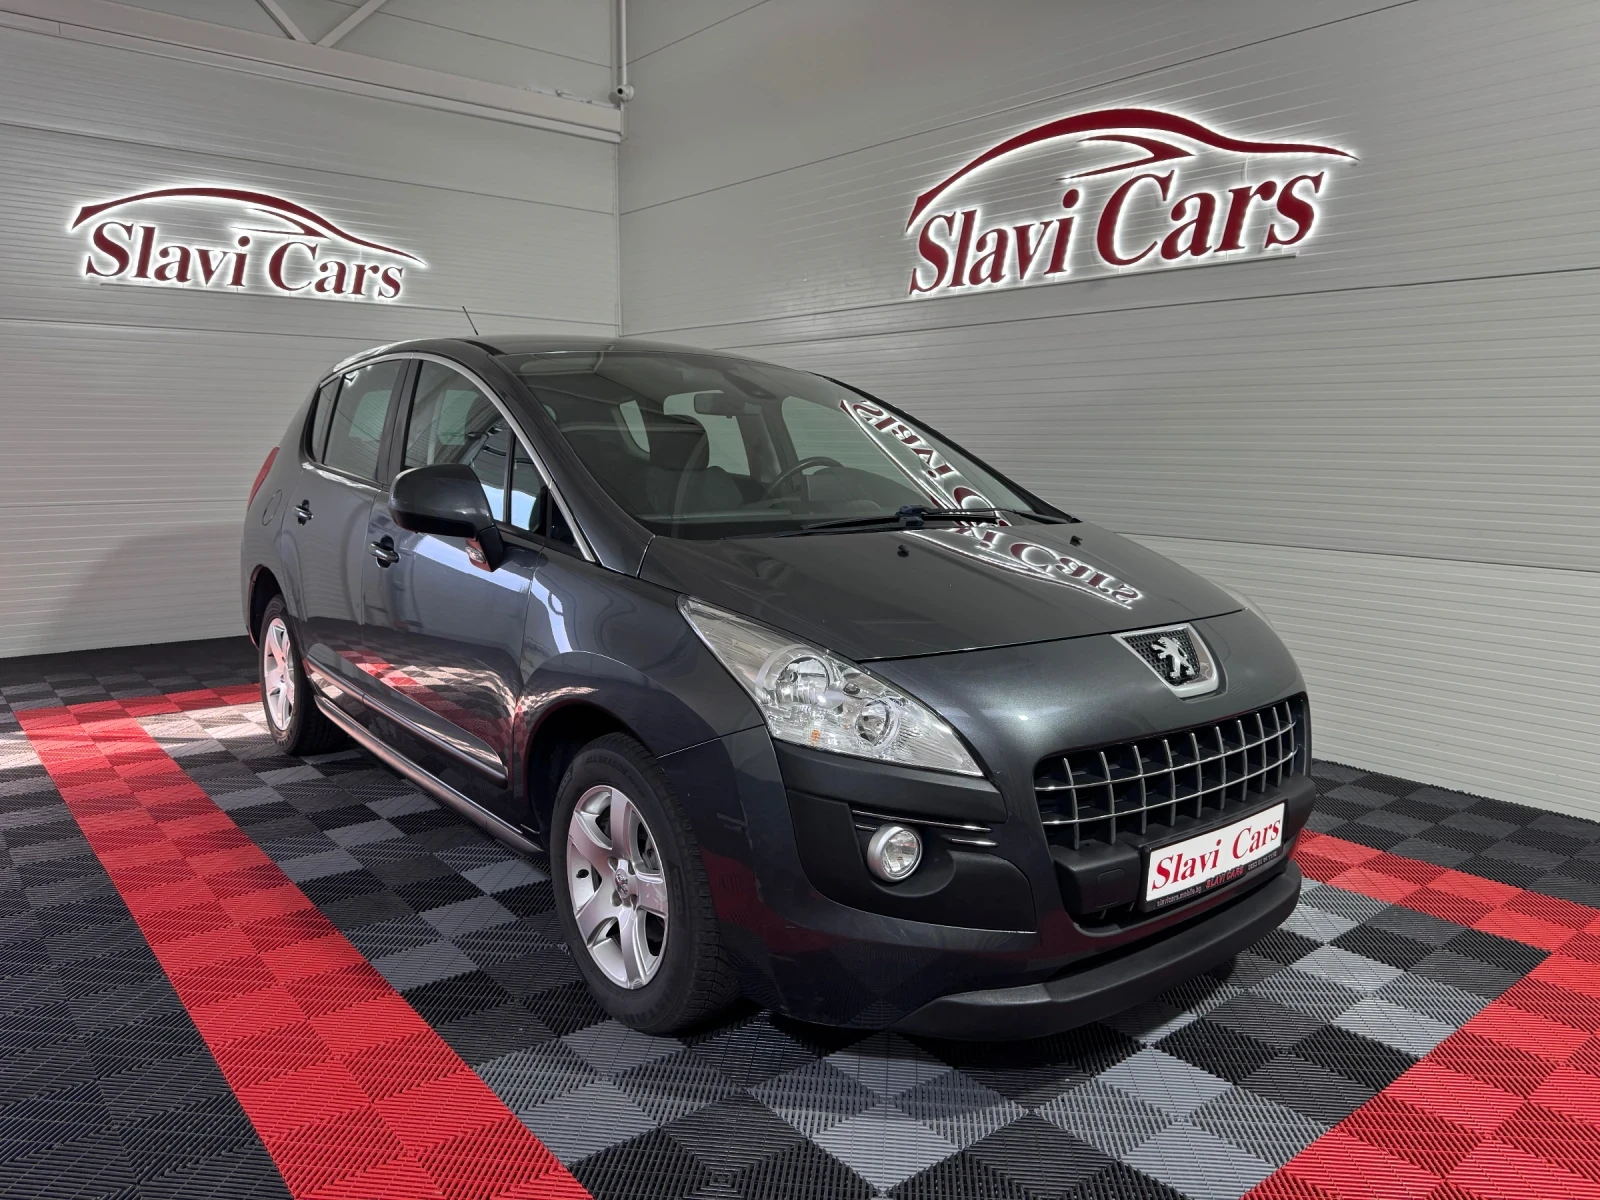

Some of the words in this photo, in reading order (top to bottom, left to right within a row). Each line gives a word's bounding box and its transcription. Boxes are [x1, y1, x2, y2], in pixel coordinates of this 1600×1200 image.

[85, 221, 251, 288] Slavi
[267, 241, 404, 299] Cars
[908, 188, 1081, 295] Slavi
[1096, 169, 1326, 267] Cars
[1151, 838, 1222, 892] Slavi
[1232, 819, 1281, 860] Cars
[1205, 873, 1226, 890] SLAVI
[1226, 865, 1244, 881] CARS
